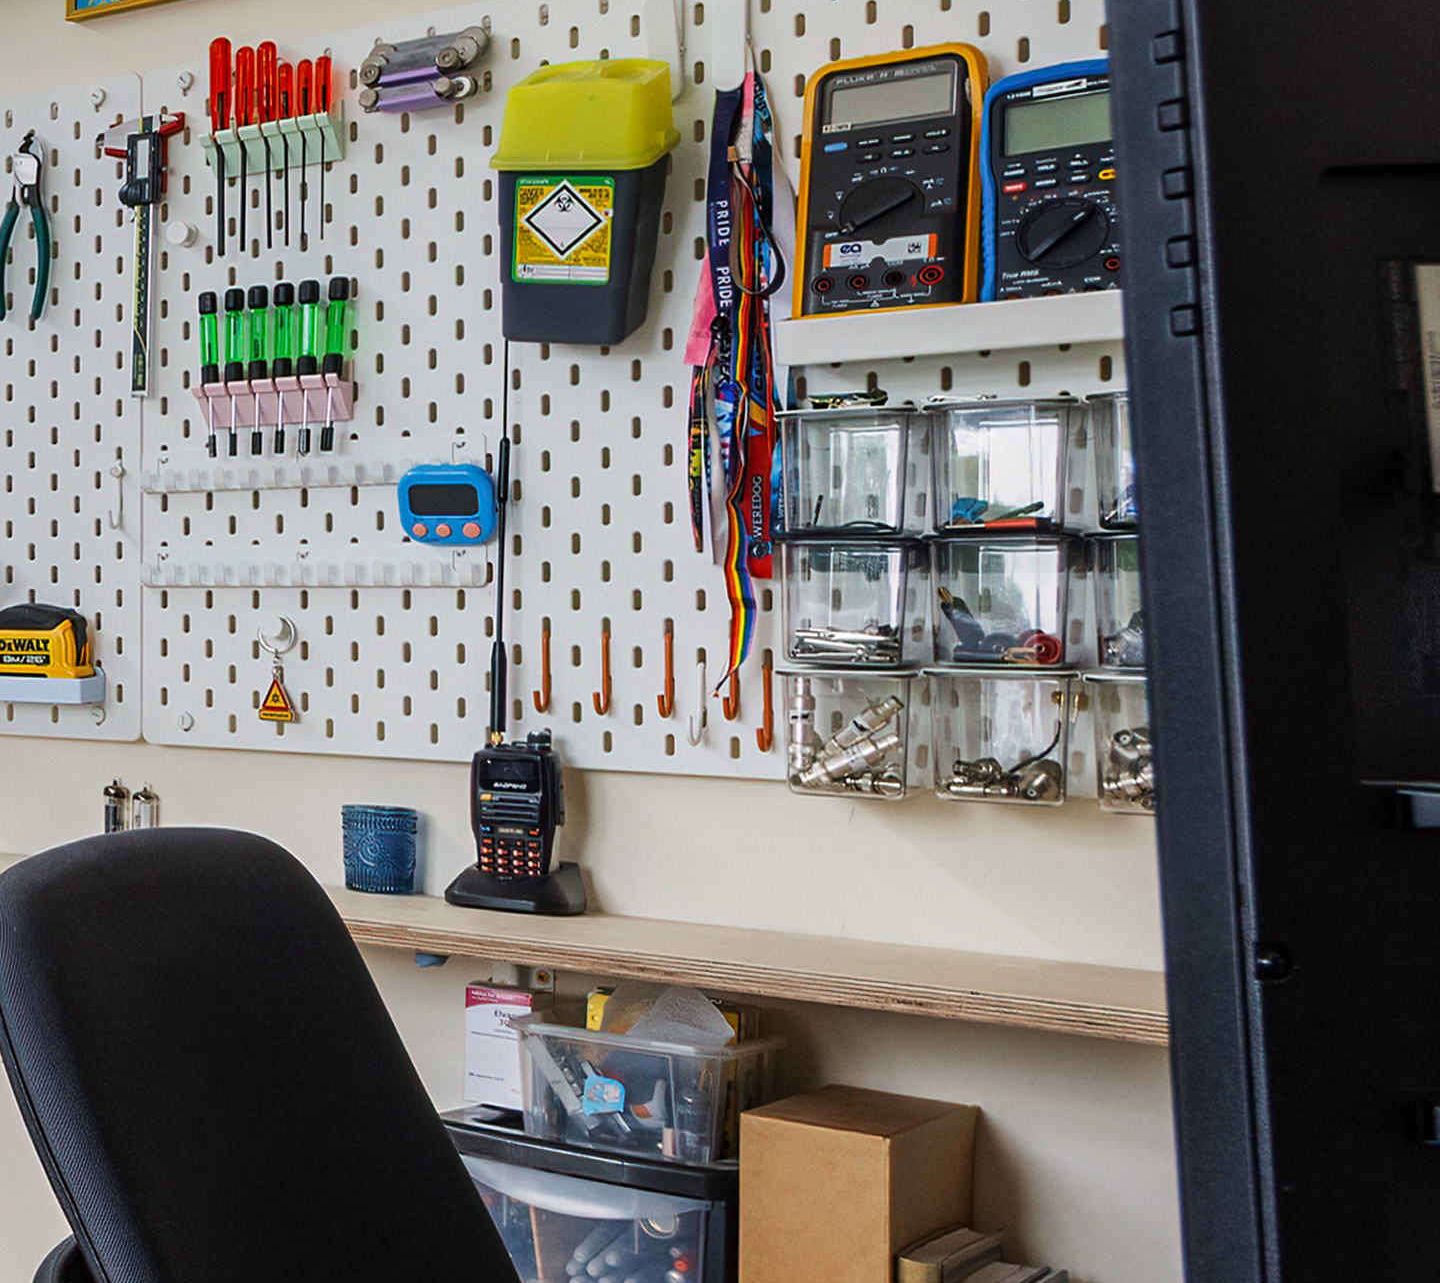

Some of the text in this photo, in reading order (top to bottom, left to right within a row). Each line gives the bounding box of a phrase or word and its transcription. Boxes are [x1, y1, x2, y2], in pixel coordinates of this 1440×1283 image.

[836, 74, 874, 85] FLUKE
[716, 200, 730, 247] PRIDE
[716, 266, 732, 308] PRIDE
[752, 475, 763, 538] WEREDOG
